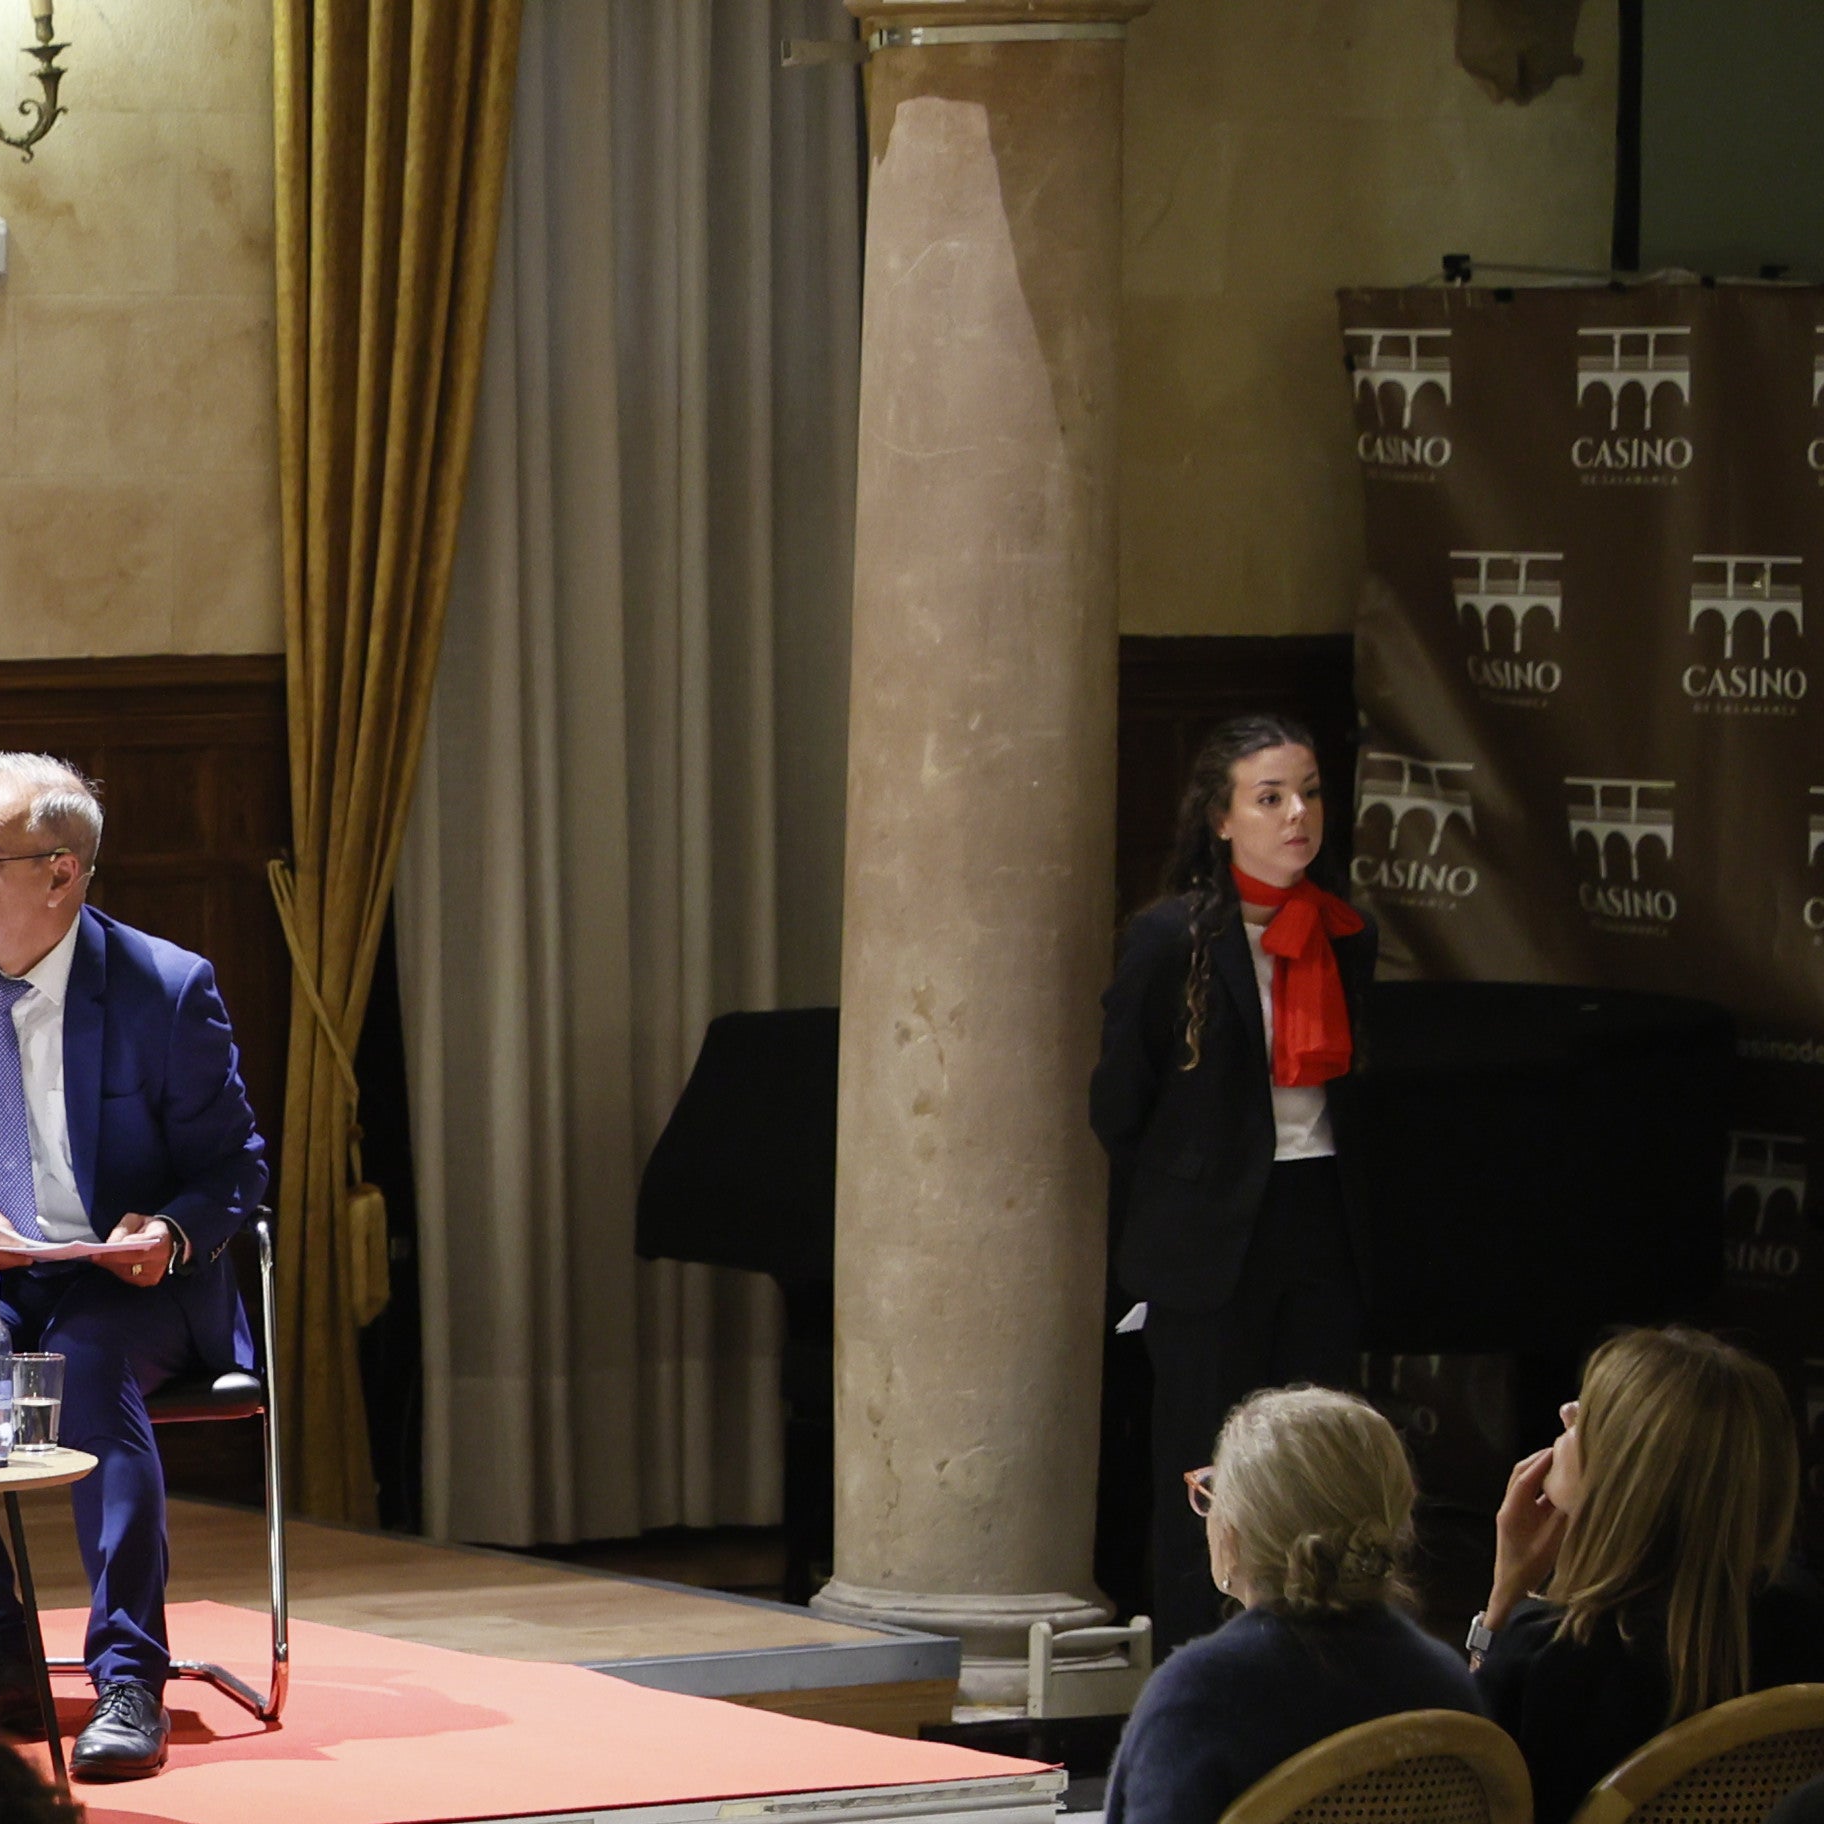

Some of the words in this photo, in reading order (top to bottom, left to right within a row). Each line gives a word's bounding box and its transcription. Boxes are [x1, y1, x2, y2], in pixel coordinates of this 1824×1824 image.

[1358, 433, 1451, 467] CASINO
[1572, 436, 1693, 470] CASINO
[1468, 657, 1562, 693] CASINO
[1683, 665, 1807, 700] CASINO
[1352, 857, 1478, 896] CASINO
[1579, 882, 1677, 921] CASINO
